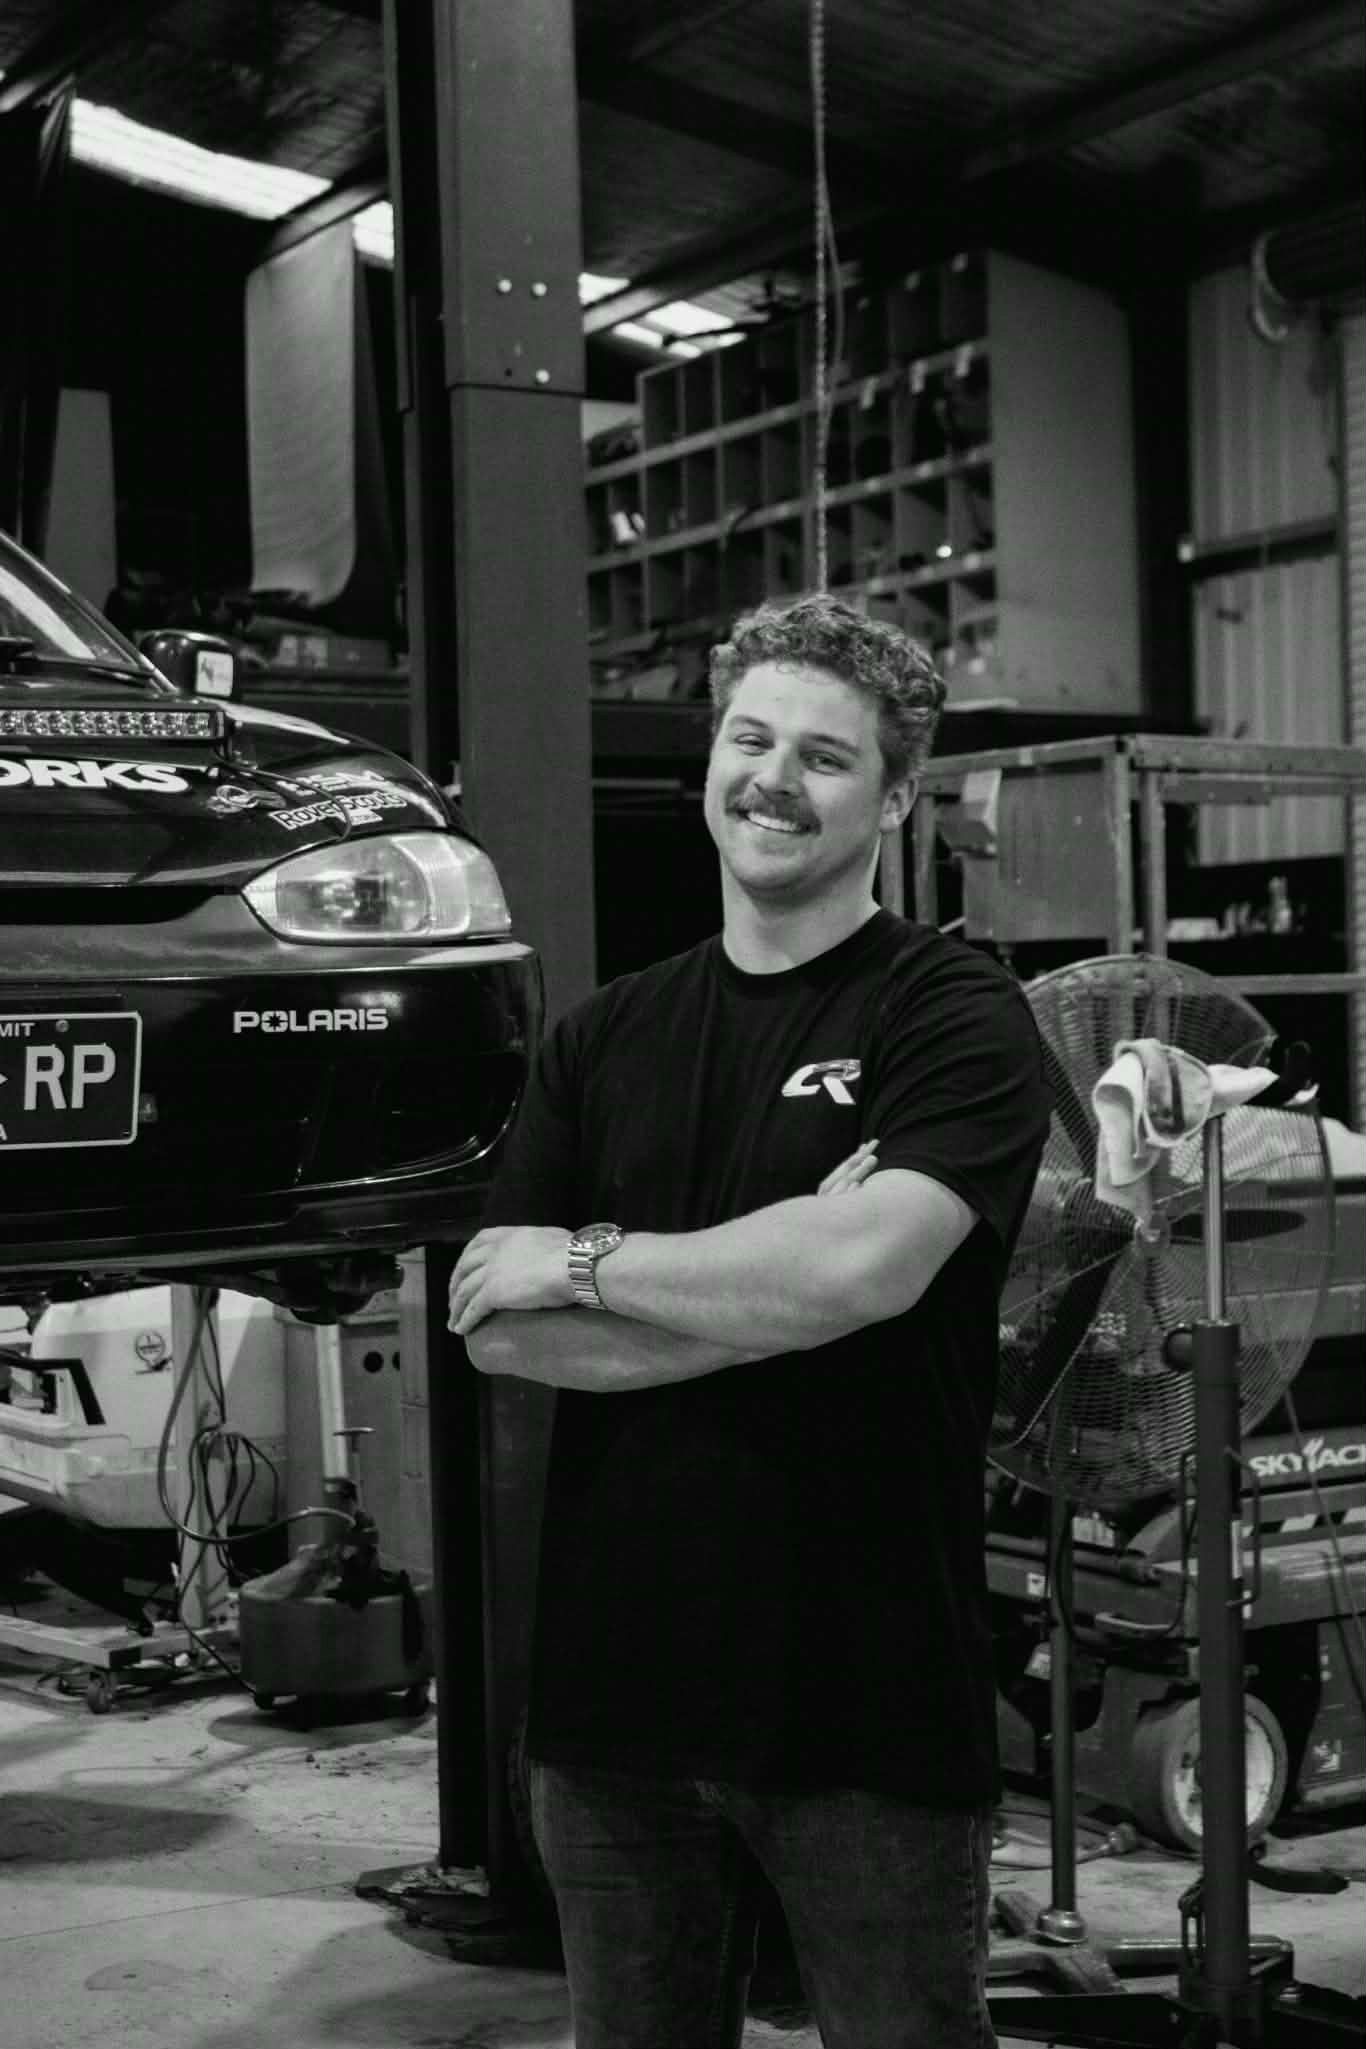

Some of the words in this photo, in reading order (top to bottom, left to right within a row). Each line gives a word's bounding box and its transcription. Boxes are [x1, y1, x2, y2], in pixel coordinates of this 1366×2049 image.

[232, 1008, 389, 1034] POLARIS
[23, 1042, 116, 1110] RP
[1247, 1437, 1366, 1477] SKYJAC
